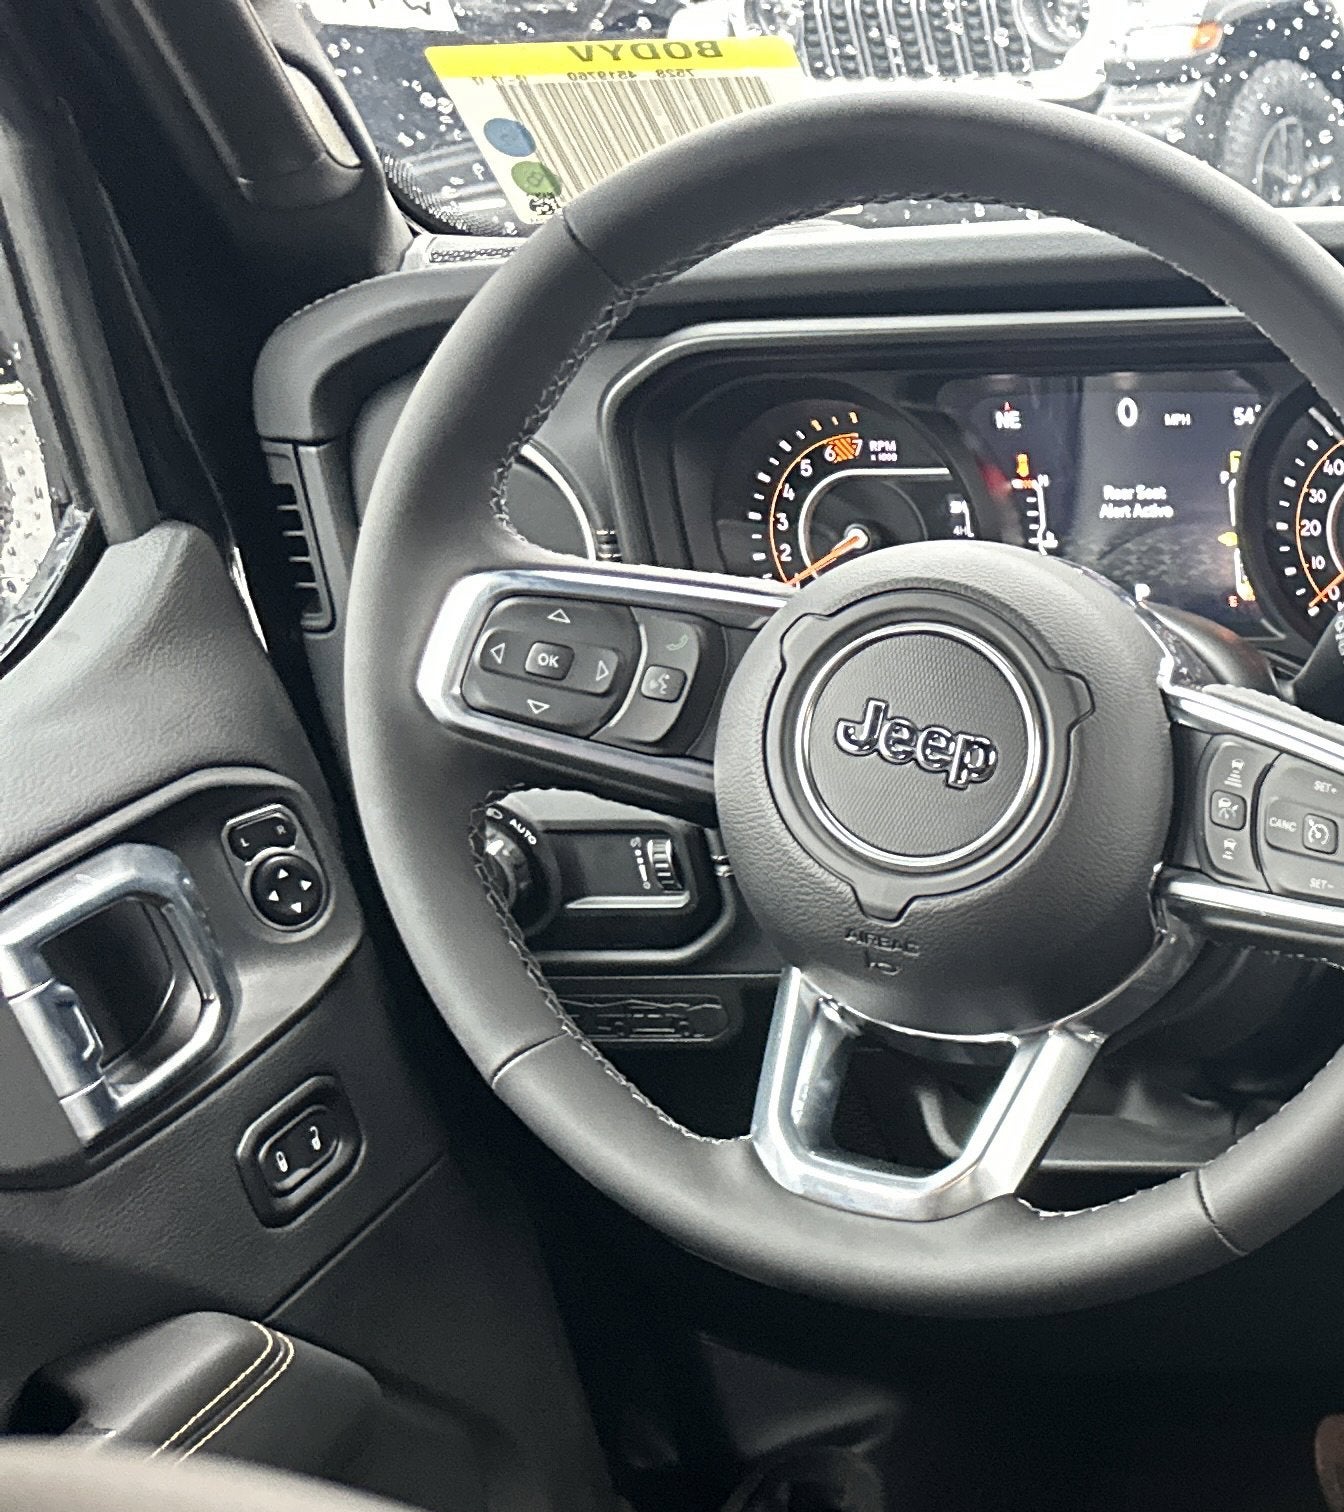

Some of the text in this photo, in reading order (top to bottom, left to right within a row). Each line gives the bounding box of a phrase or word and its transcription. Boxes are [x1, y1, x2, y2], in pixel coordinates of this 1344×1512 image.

[995, 411, 1021, 429] NE
[1117, 397, 1139, 428] 0
[1164, 413, 1191, 425] MPH
[824, 444, 836, 461] 6
[852, 439, 863, 456] 7
[869, 440, 897, 452] RPM
[800, 459, 813, 477] 5
[782, 483, 795, 501] 4
[1308, 488, 1327, 503] 30
[776, 512, 789, 531] 3
[1300, 519, 1321, 536] 20
[779, 543, 792, 561] 2
[1311, 556, 1325, 570] 10
[537, 652, 560, 669] OK
[835, 697, 999, 789] Jeep
[276, 824, 287, 836] R
[510, 818, 537, 846] AUTO
[1269, 816, 1297, 833] CANC
[239, 836, 250, 848] L
